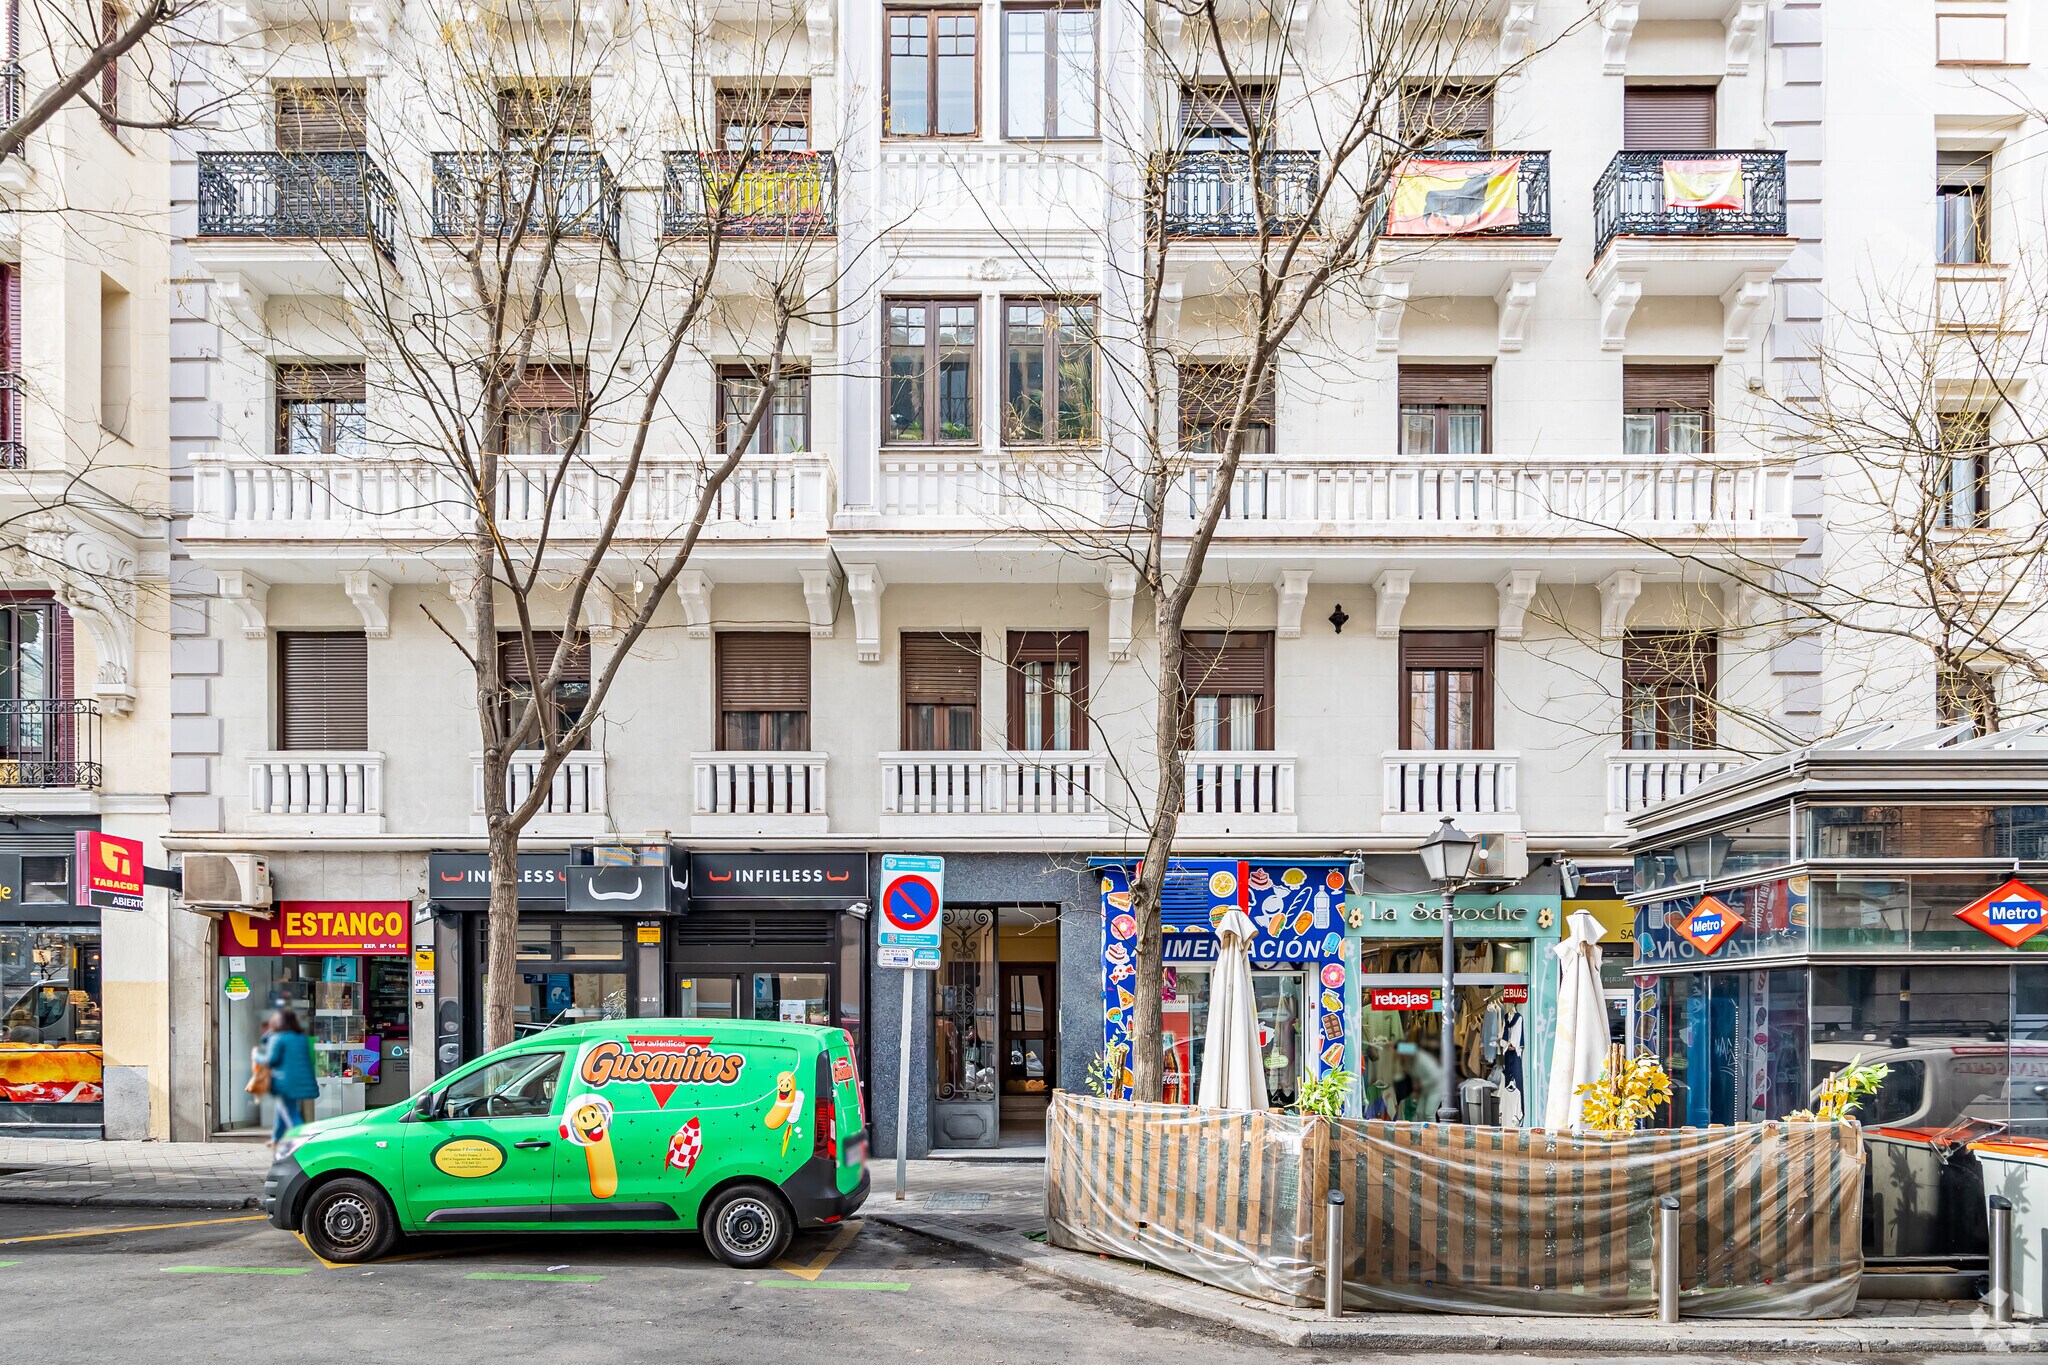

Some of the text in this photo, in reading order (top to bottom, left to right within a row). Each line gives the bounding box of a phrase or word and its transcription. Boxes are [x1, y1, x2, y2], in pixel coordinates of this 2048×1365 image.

[736, 870, 822, 882] INFIELESS
[94, 877, 140, 891] TABACOS
[1370, 901, 1398, 921] La
[1992, 906, 2038, 920] Metro
[286, 912, 402, 936] ESTANCO
[1470, 924, 1528, 934] Complementos
[1694, 920, 1720, 932] Metro
[1375, 992, 1429, 1008] rebajas
[581, 1042, 744, 1087] Gusanitos
